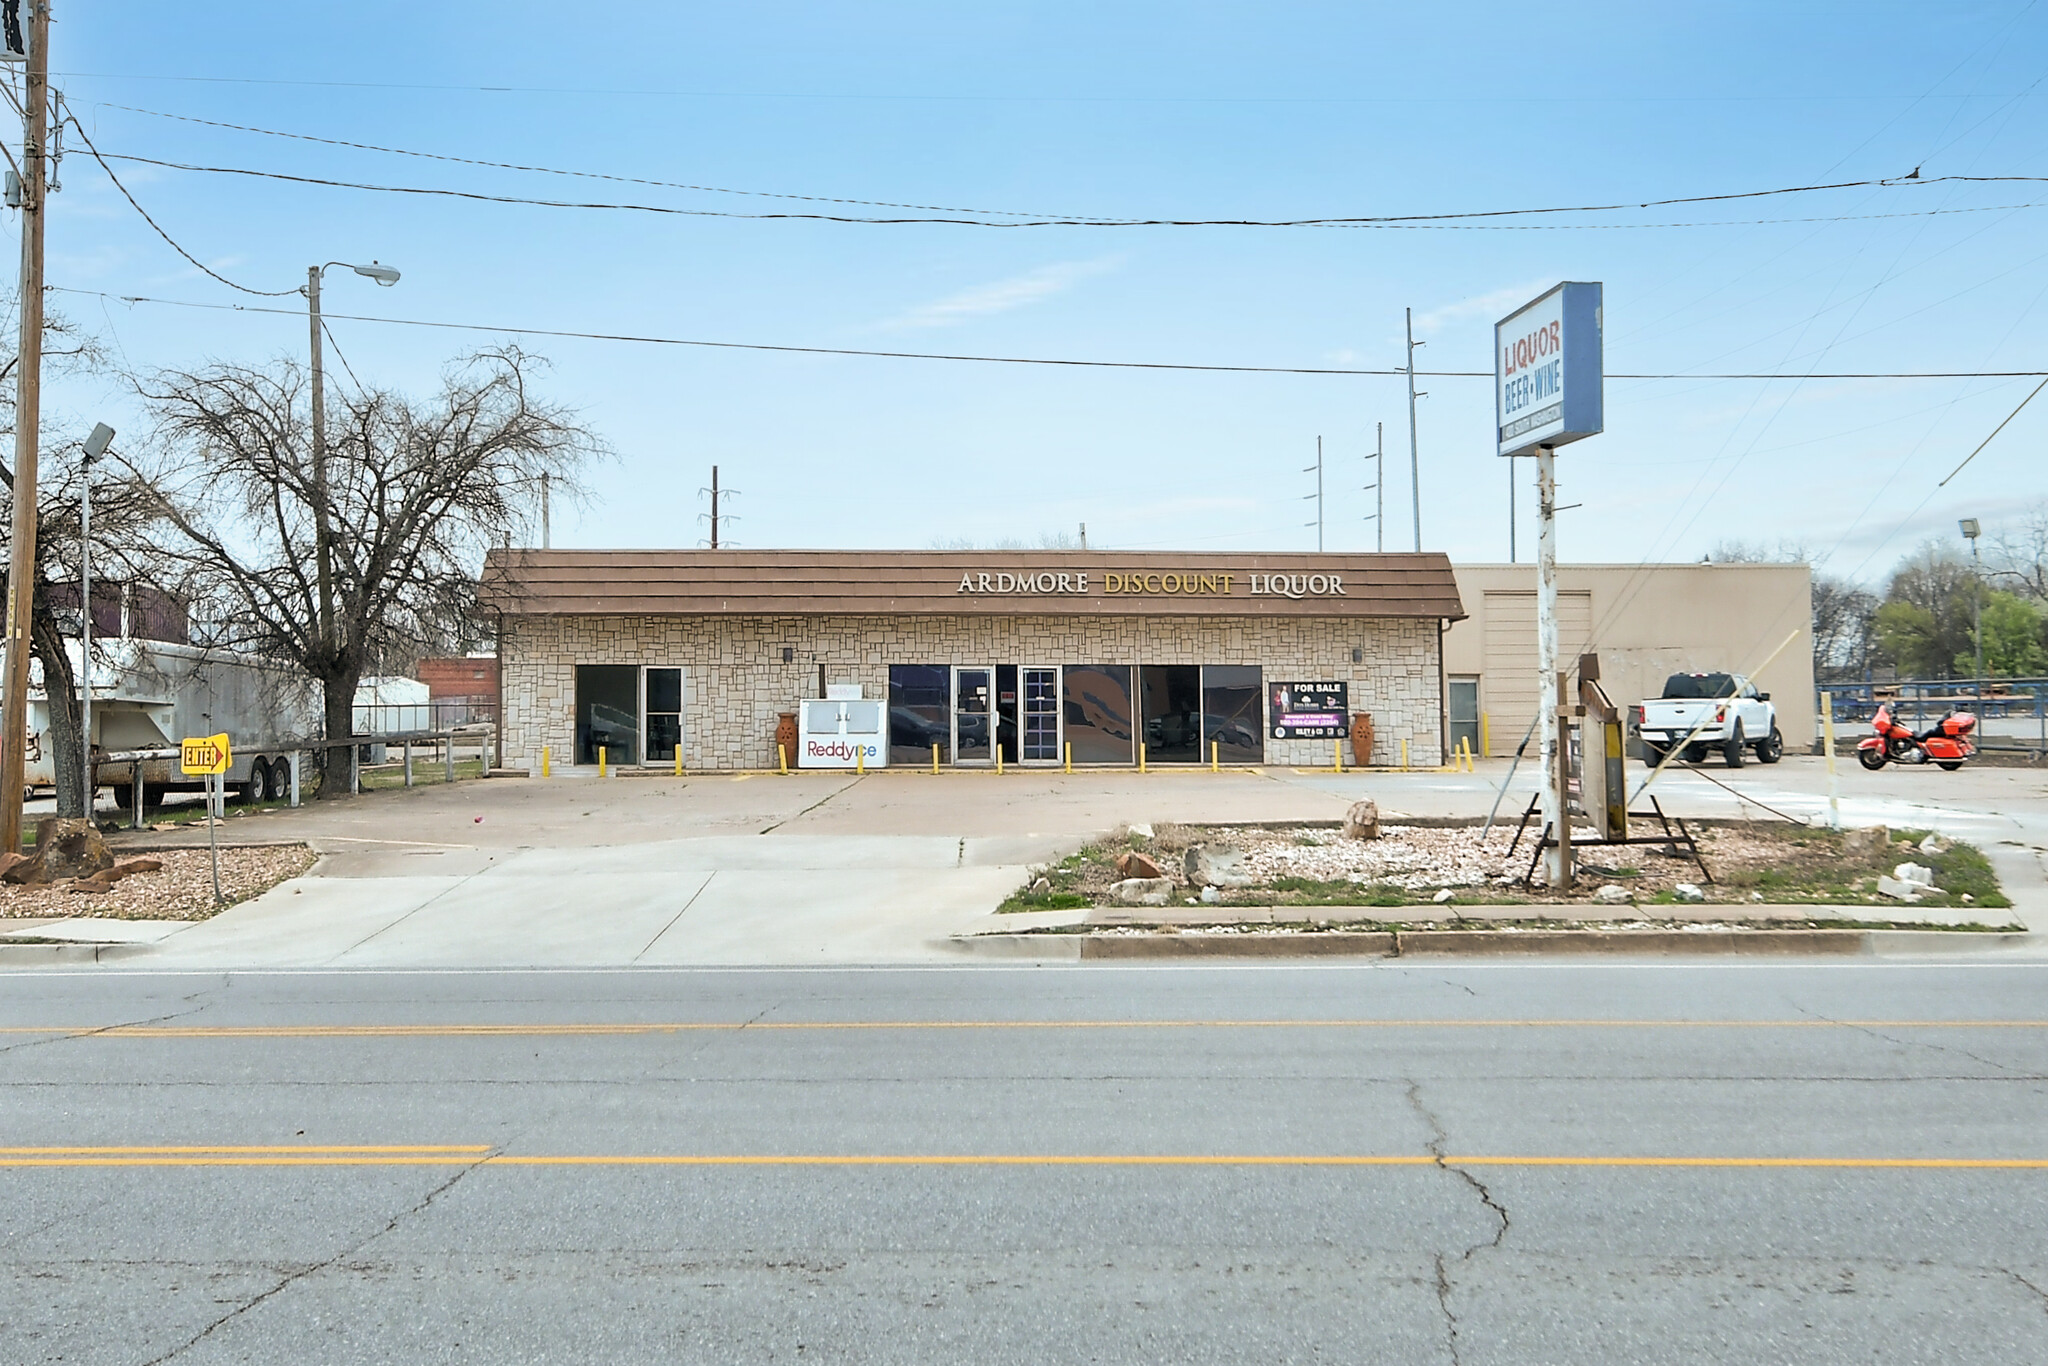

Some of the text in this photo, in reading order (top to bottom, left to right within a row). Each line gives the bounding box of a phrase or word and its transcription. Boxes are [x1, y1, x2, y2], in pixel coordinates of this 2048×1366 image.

[1505, 320, 1560, 377] LIQUOR
[1505, 359, 1560, 414] BEER WINE
[956, 572, 1347, 599] ARDMORE DISCOUNT LIQUOR
[1294, 684, 1341, 693] FOR SALE
[184, 746, 217, 767] ENTER
